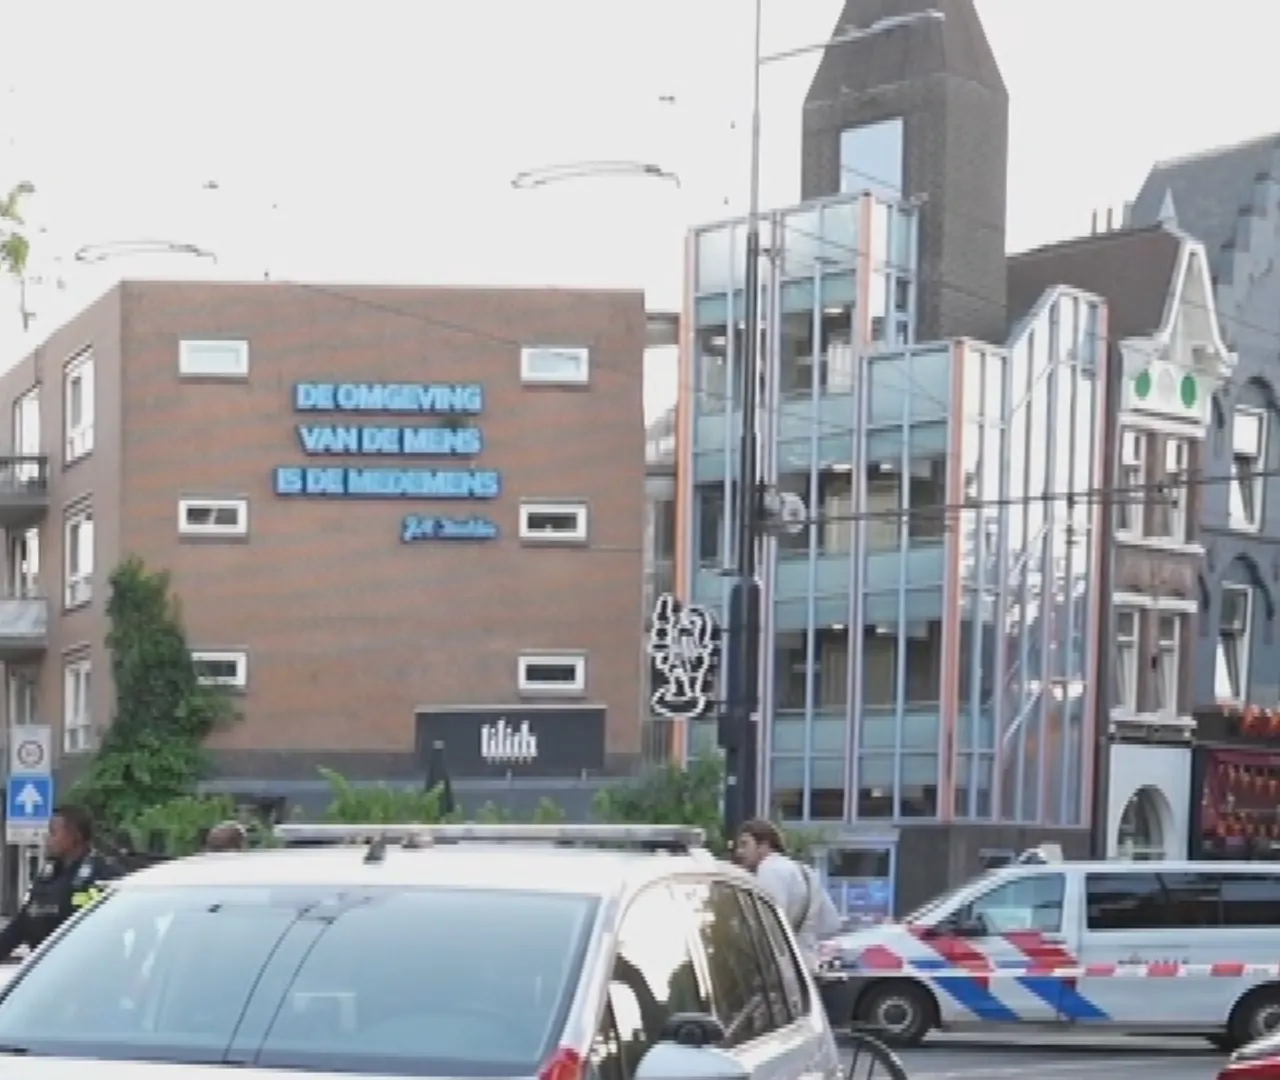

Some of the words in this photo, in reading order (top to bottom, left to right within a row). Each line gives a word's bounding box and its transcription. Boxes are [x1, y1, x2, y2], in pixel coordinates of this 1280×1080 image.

[295, 383, 335, 411] DE
[336, 384, 483, 413] OMGEVING
[298, 426, 359, 453] VAN
[361, 427, 401, 453] DE
[403, 427, 482, 454] MENS
[276, 467, 303, 494] IS
[305, 467, 345, 494] DE
[347, 468, 500, 497] MEDEMENS
